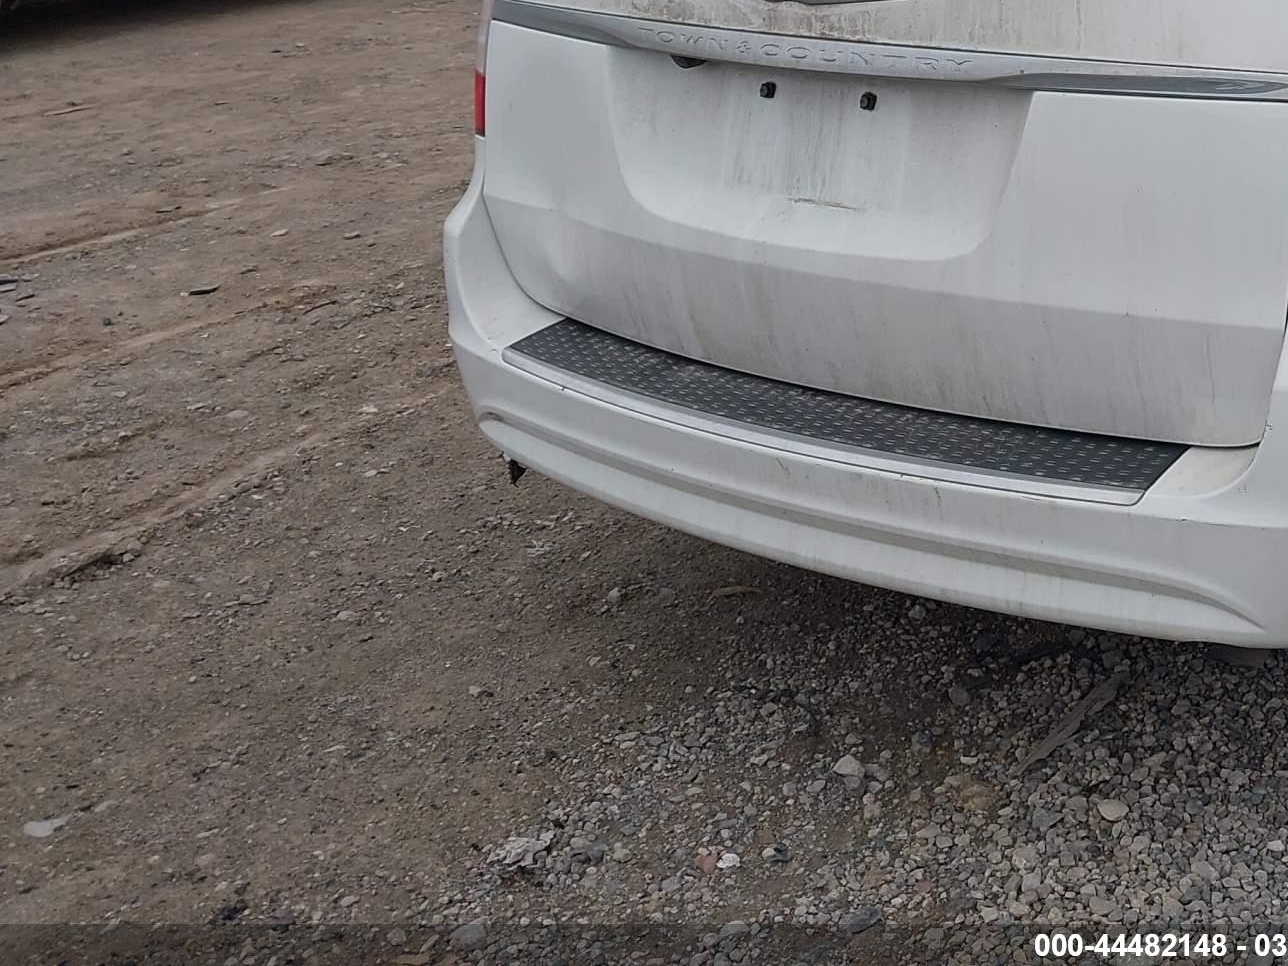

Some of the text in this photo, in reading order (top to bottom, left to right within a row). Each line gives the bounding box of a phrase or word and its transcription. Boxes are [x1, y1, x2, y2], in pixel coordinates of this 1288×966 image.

[637, 27, 974, 71] TOWN & COUNTRY
